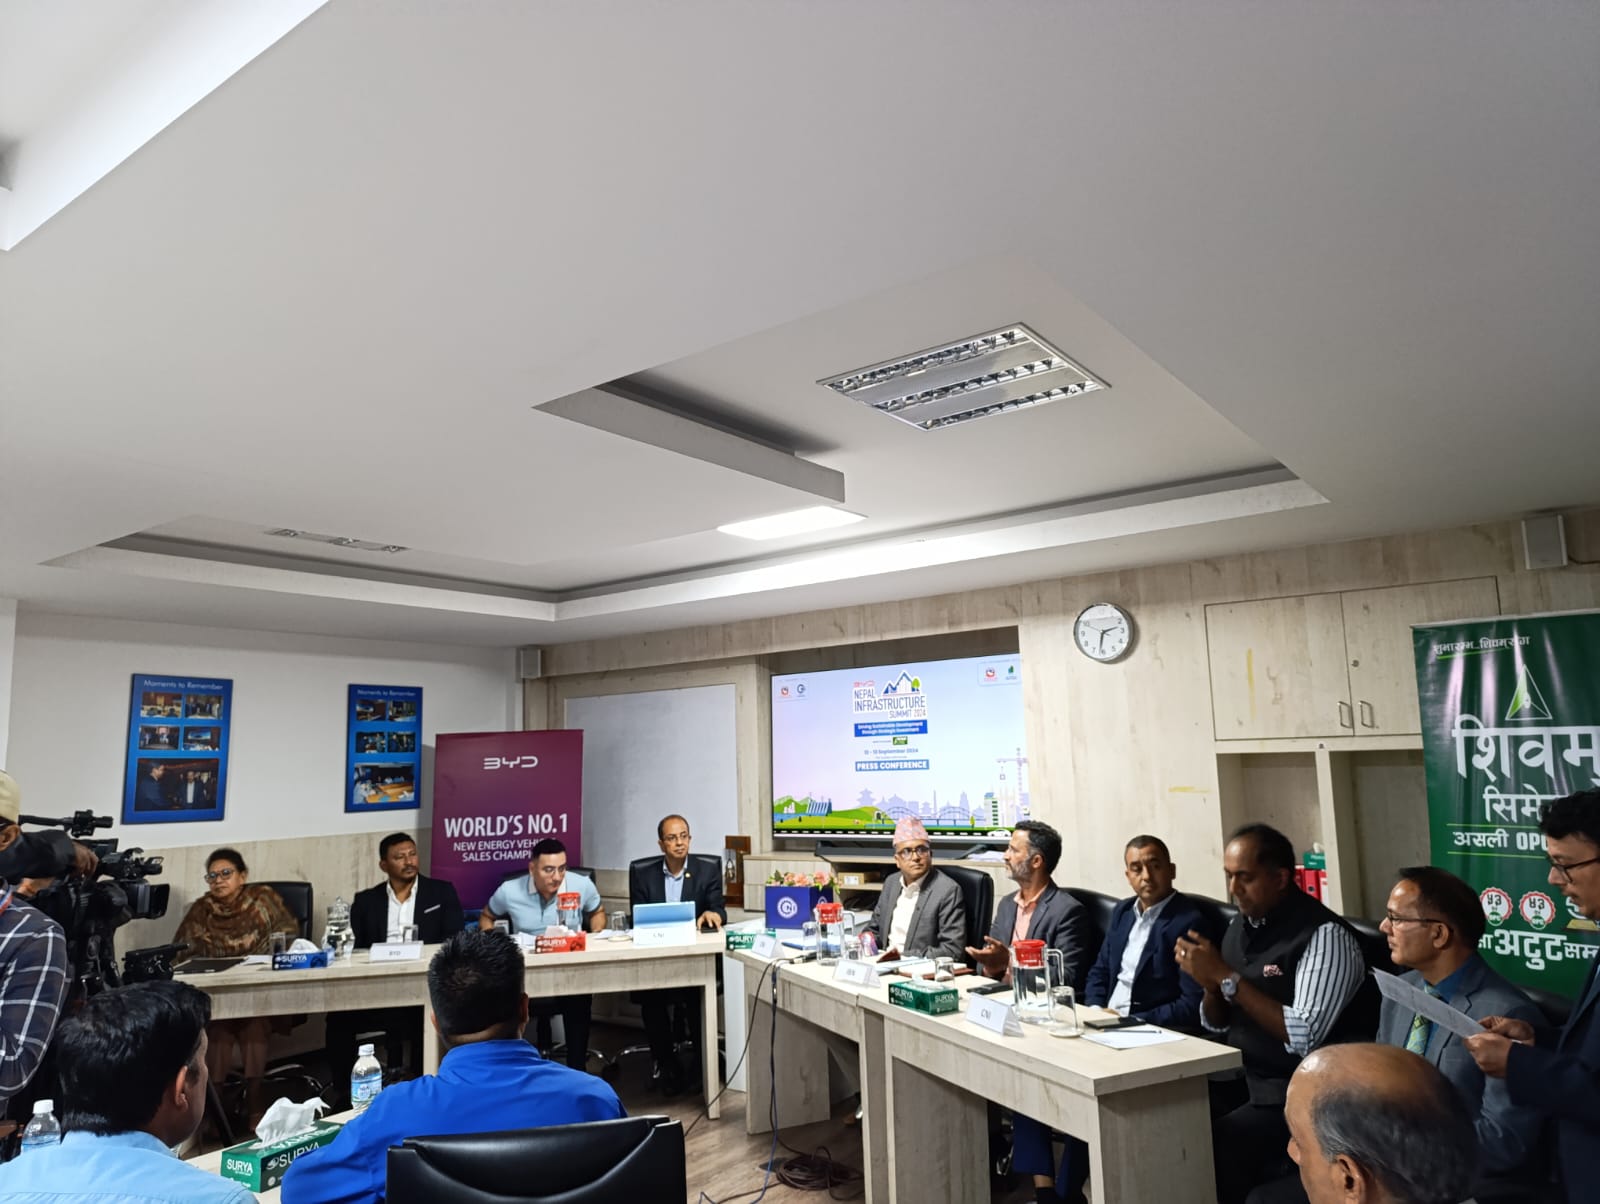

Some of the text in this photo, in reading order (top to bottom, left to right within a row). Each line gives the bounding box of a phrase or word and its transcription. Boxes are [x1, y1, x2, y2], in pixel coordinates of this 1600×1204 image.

[854, 688, 875, 700] NEPAL
[854, 695, 926, 712] INFRASTRUCTURE
[889, 709, 912, 719] SUMMIT
[483, 755, 539, 770] BYD
[857, 760, 928, 770] PRESS CONFERENCE
[444, 814, 524, 838] WORLD'S
[1452, 828, 1510, 848] असली
[453, 841, 476, 852] NEW
[478, 839, 516, 851] ENERGY
[462, 849, 532, 863] SALES CHAMPI
[542, 938, 568, 947] SURYA
[1494, 929, 1567, 970] अटुट
[281, 954, 307, 963] SURYA
[894, 988, 914, 1001] SURYA
[934, 992, 956, 1004] SURYA
[226, 1158, 254, 1174] SURYA
